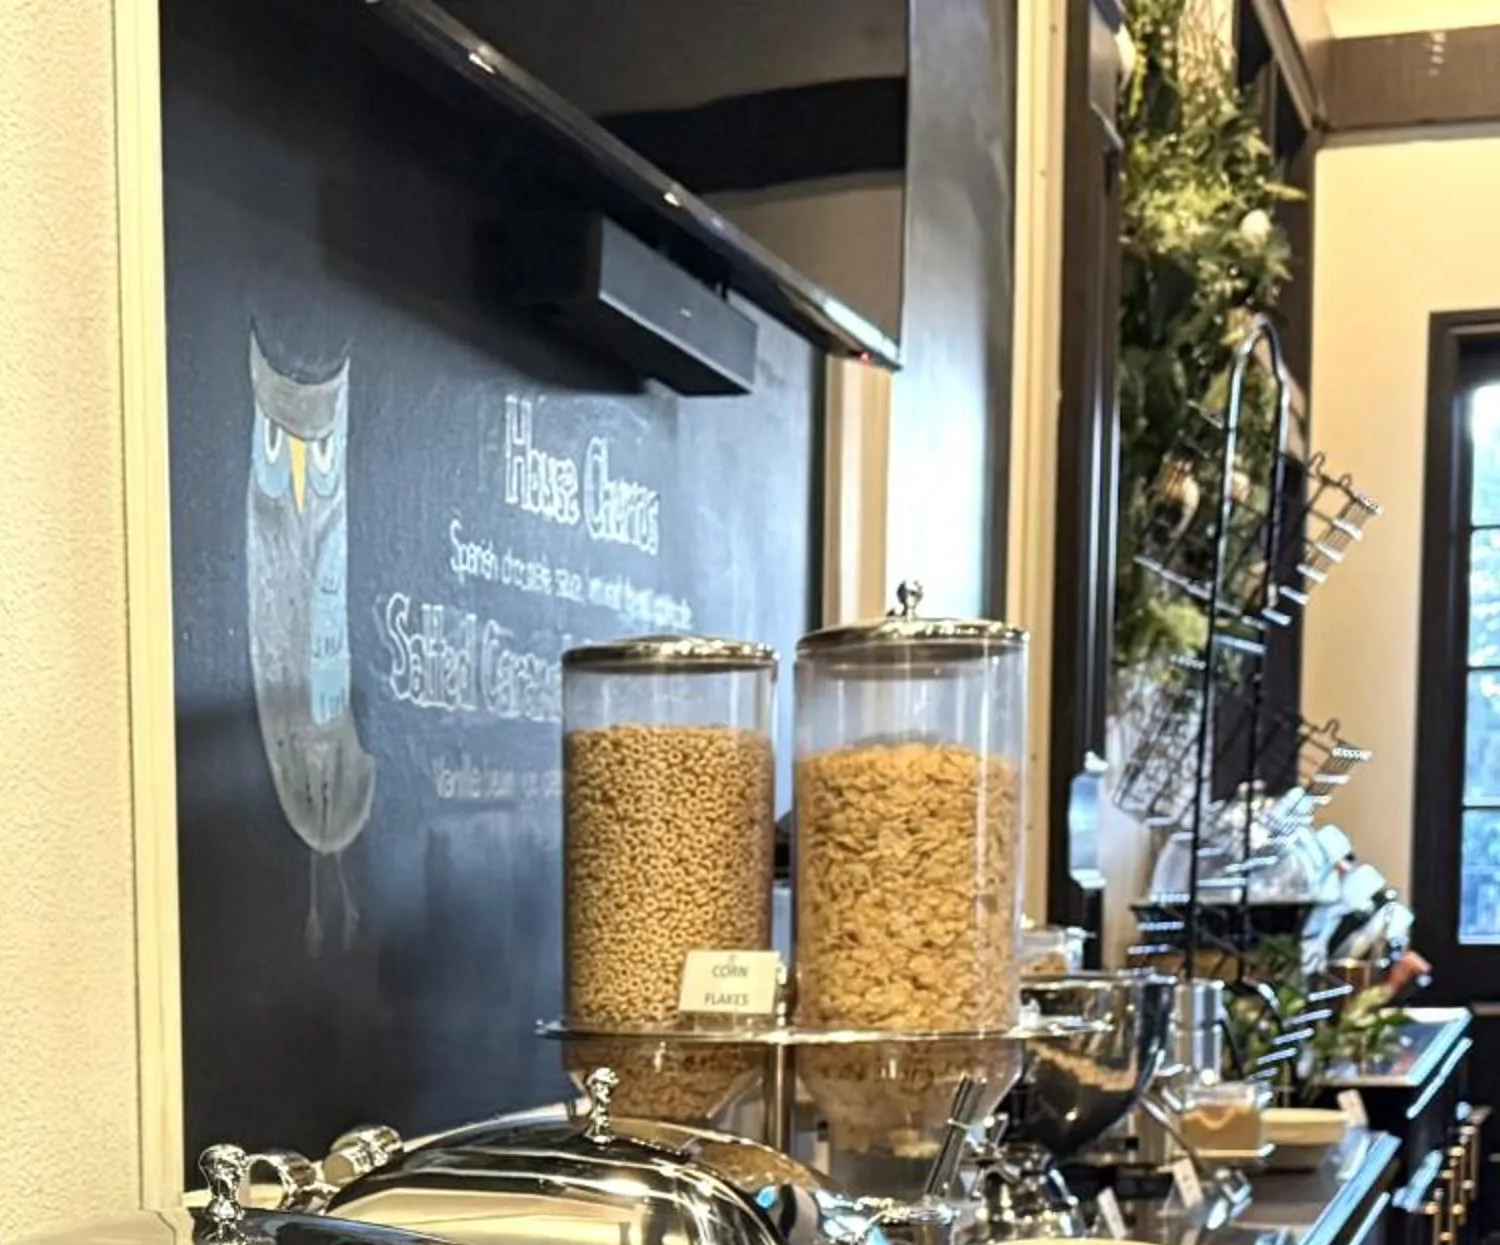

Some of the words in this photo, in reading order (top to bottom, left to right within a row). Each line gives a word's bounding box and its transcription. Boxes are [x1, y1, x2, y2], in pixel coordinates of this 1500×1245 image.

[386, 592, 479, 712] Salted
[711, 964, 749, 980] CORN
[704, 992, 750, 1007] FLAKES
